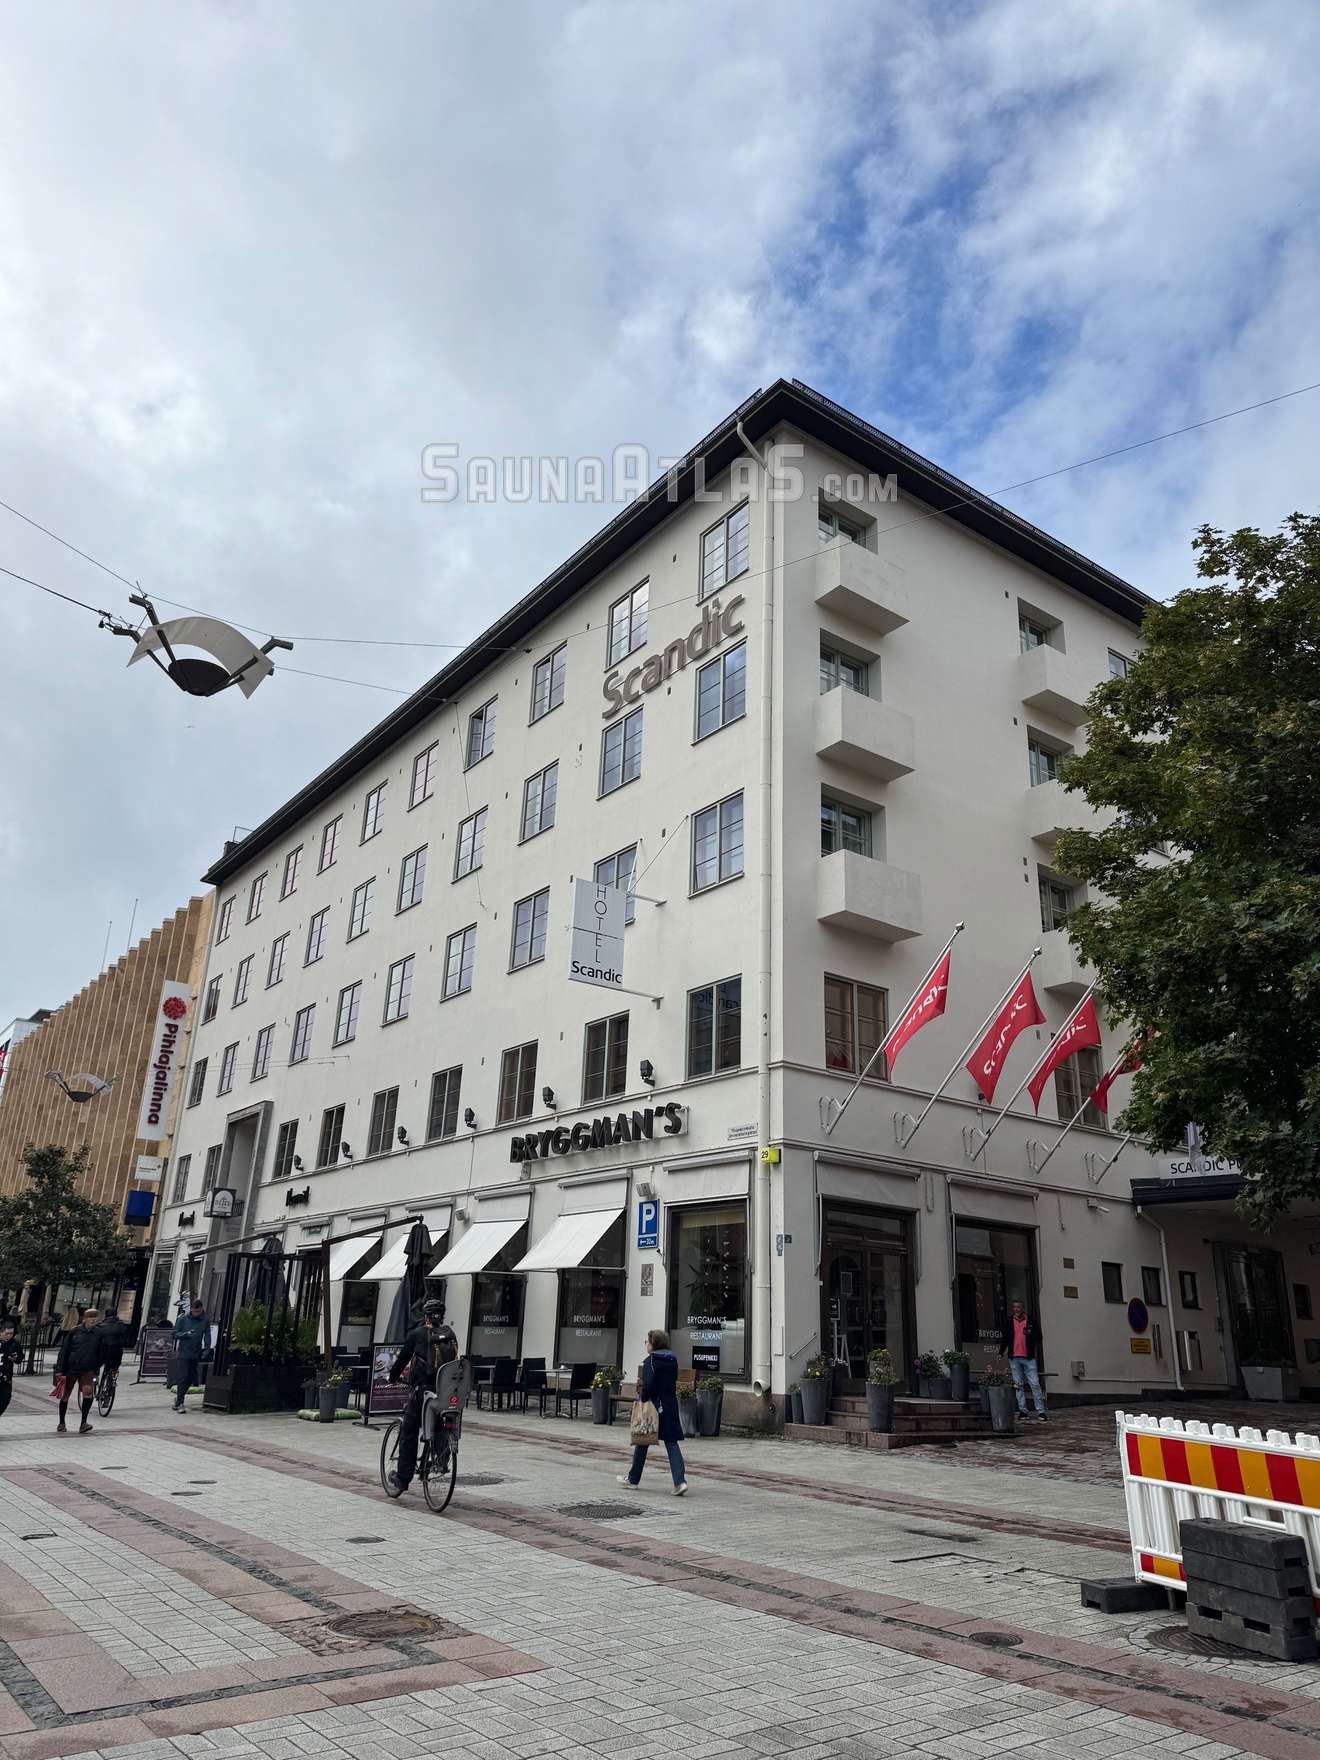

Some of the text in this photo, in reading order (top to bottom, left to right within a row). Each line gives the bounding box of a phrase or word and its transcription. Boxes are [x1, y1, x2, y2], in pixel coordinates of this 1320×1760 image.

[602, 593, 745, 719] Scandic
[594, 884, 608, 964] HOTEL
[571, 961, 623, 984] Scandic
[147, 1022, 179, 1125] Pihlajalinna
[510, 1101, 682, 1163] BRYGGMAN'S
[761, 1150, 769, 1159] 29
[1170, 1160, 1224, 1174] SCADIC
[642, 1202, 655, 1234] P
[688, 1316, 727, 1325] BRYGGMAN'S
